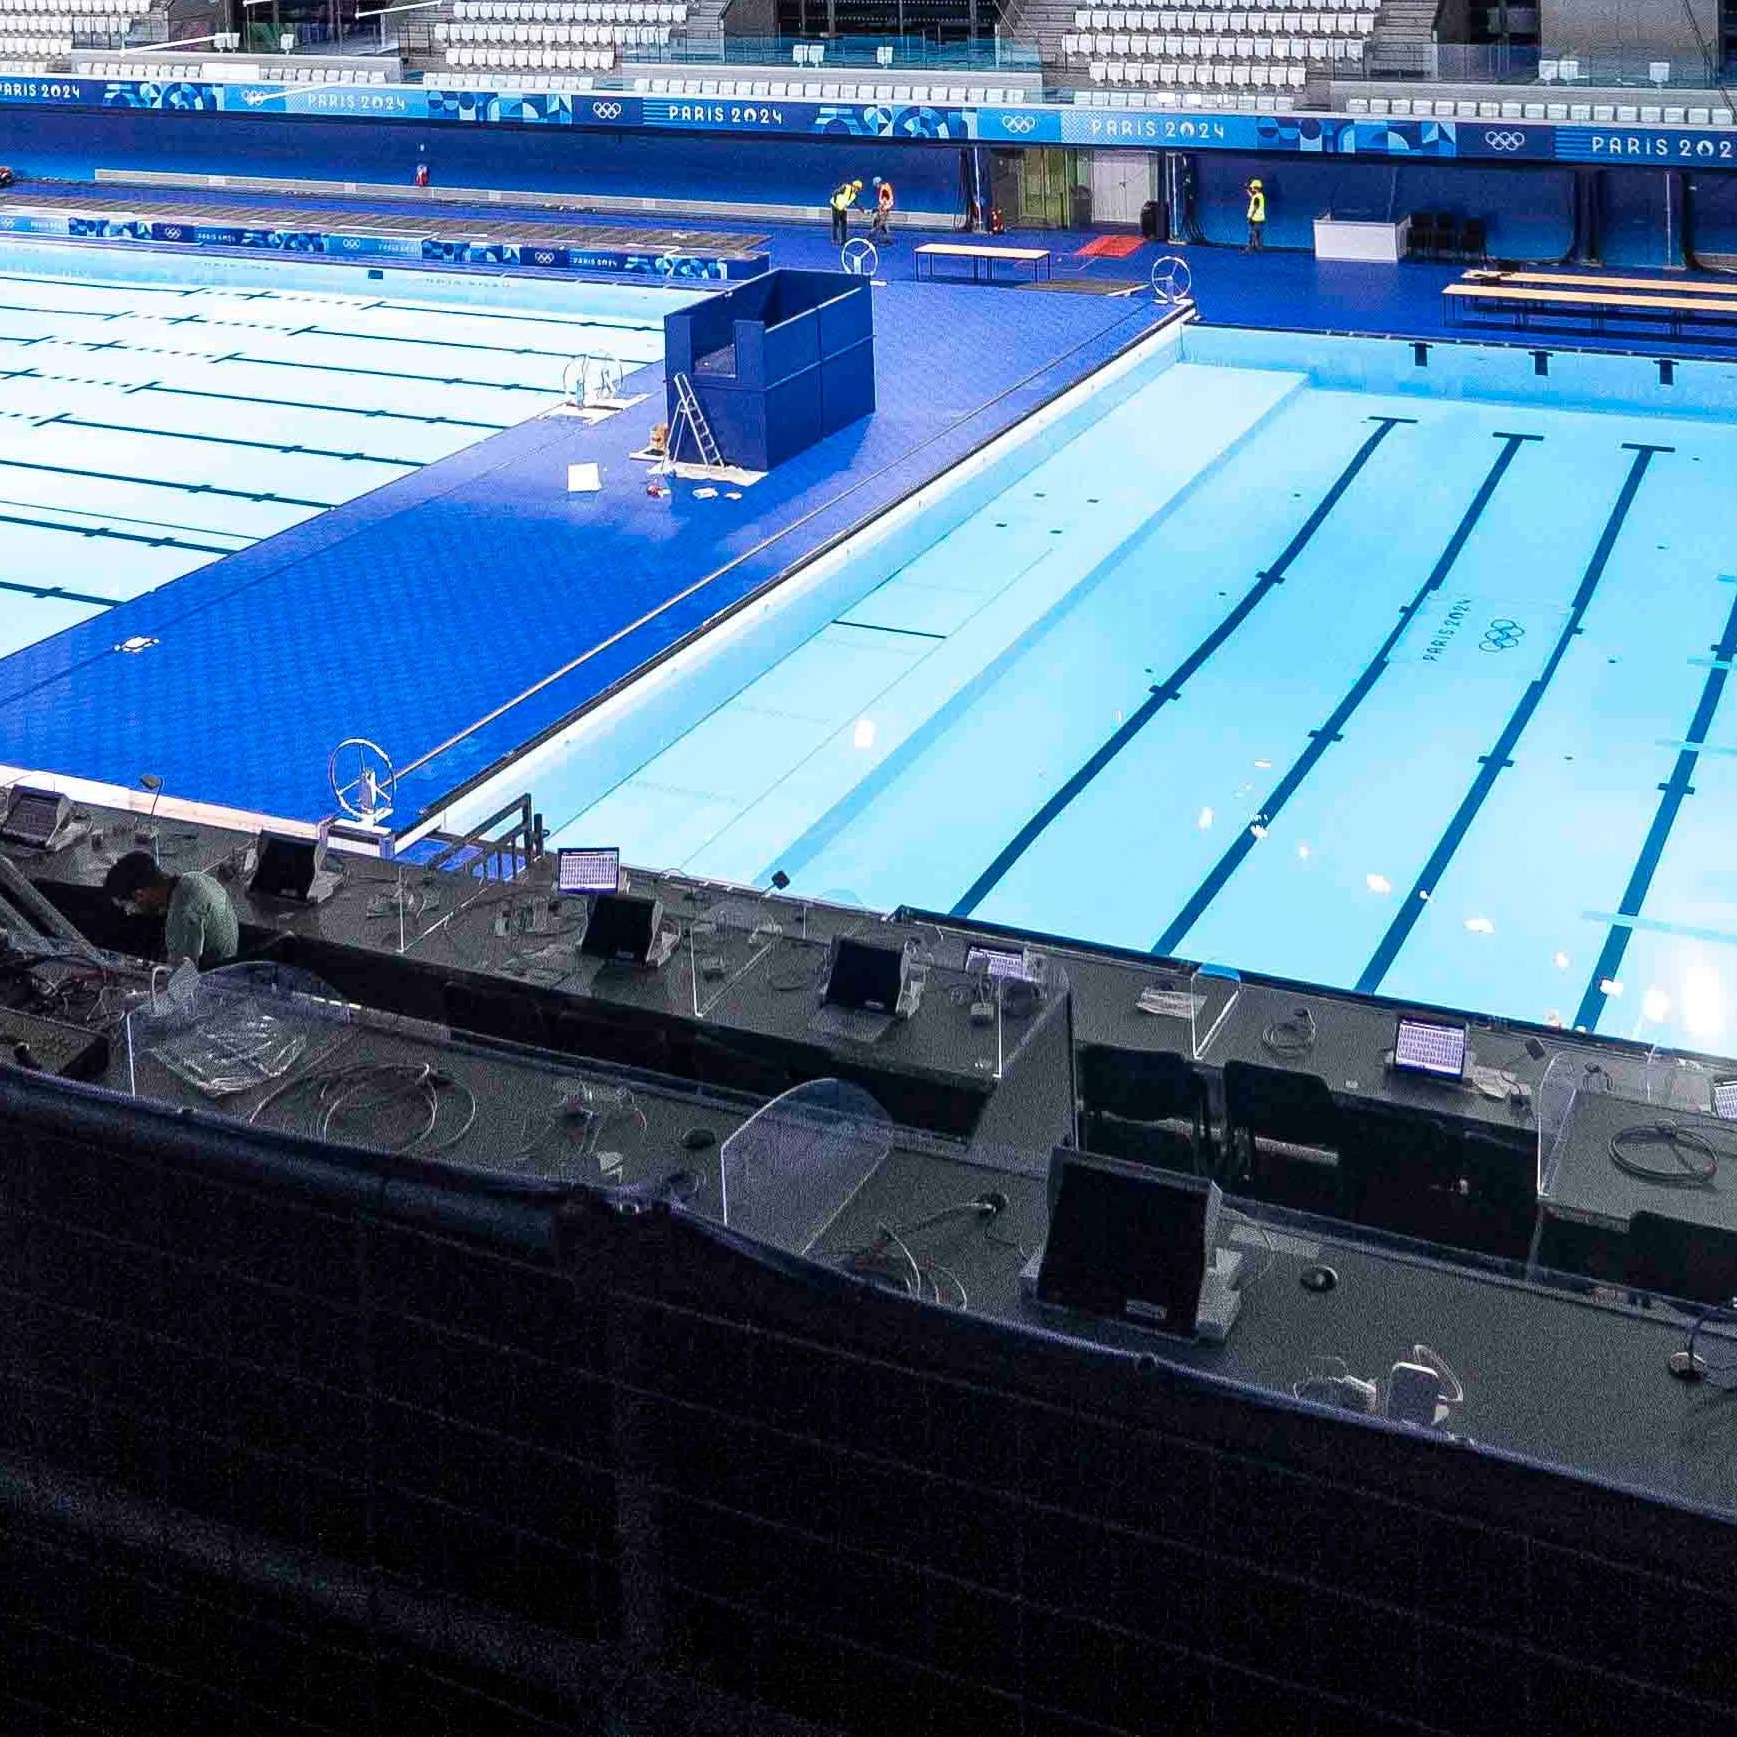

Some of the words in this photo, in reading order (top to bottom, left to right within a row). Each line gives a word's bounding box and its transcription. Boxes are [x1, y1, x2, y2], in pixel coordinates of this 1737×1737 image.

[41, 86, 80, 100] 2024
[359, 94, 406, 111] 2024
[731, 107, 782, 124] 2024
[1164, 120, 1224, 139] 2024
